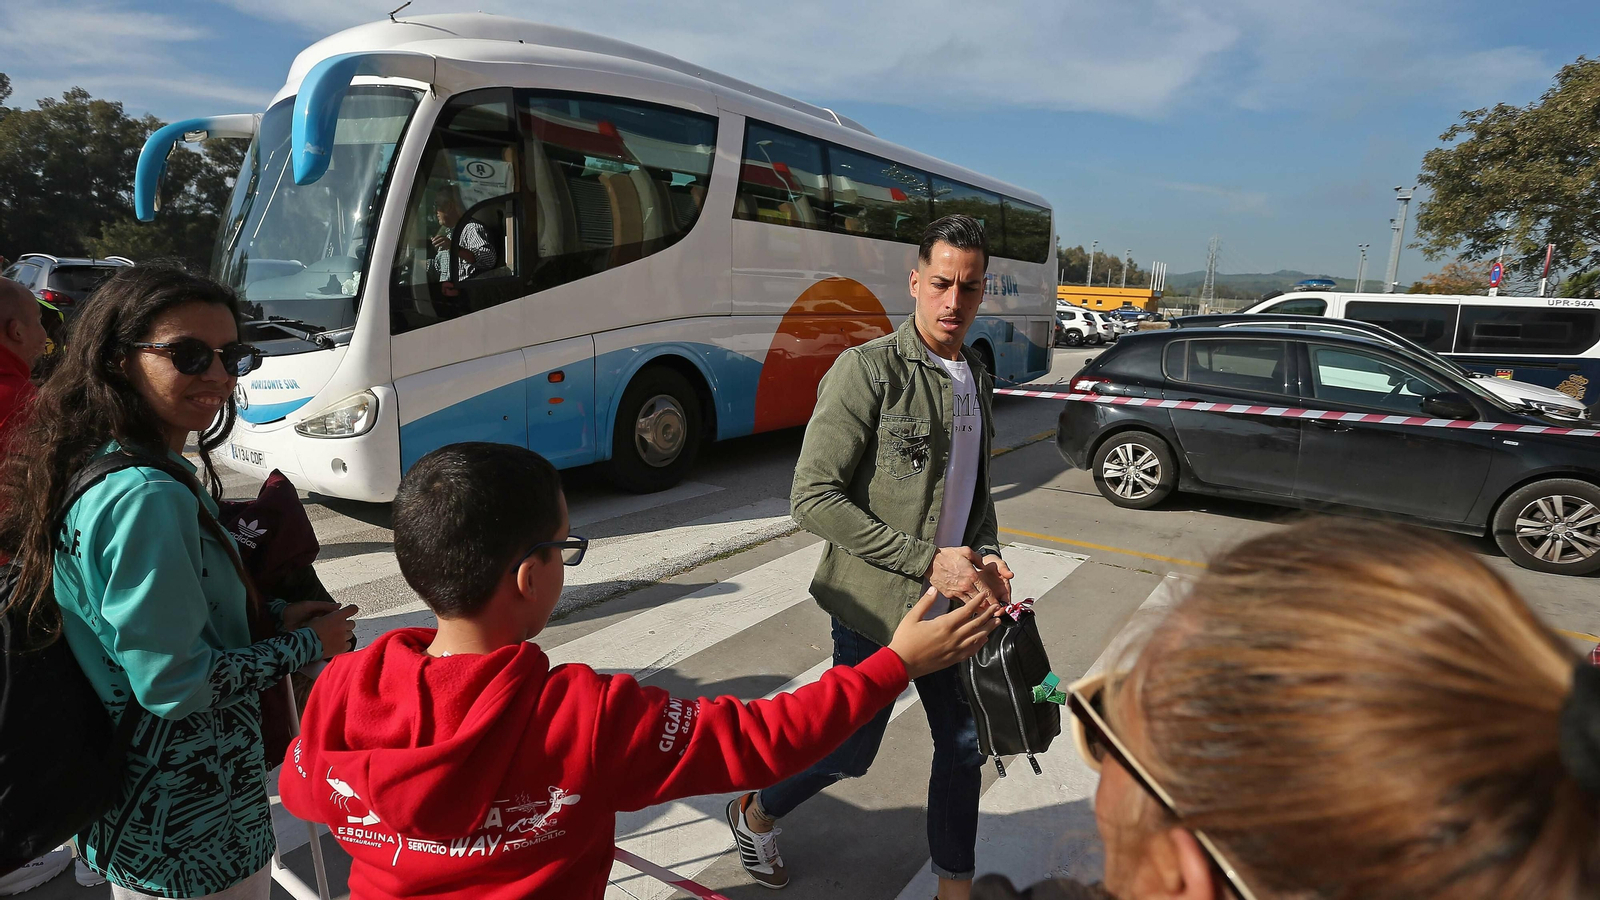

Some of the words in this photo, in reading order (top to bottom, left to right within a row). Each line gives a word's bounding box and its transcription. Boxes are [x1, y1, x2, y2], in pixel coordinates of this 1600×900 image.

[1001, 274, 1019, 296] SUR
[1547, 299, 1595, 307] UPR-94A
[250, 380, 283, 390] HORIZONTE
[284, 379, 300, 390] SUR
[250, 451, 263, 465] CDF
[684, 706, 693, 721] los
[681, 721, 691, 734] de
[337, 826, 396, 845] ESQUINA
[342, 836, 382, 848] RESTAURANTE
[407, 841, 447, 855] SERVICIO
[449, 834, 502, 857] WAY
[502, 844, 511, 853] A
[513, 830, 566, 850] DOMICILIO
